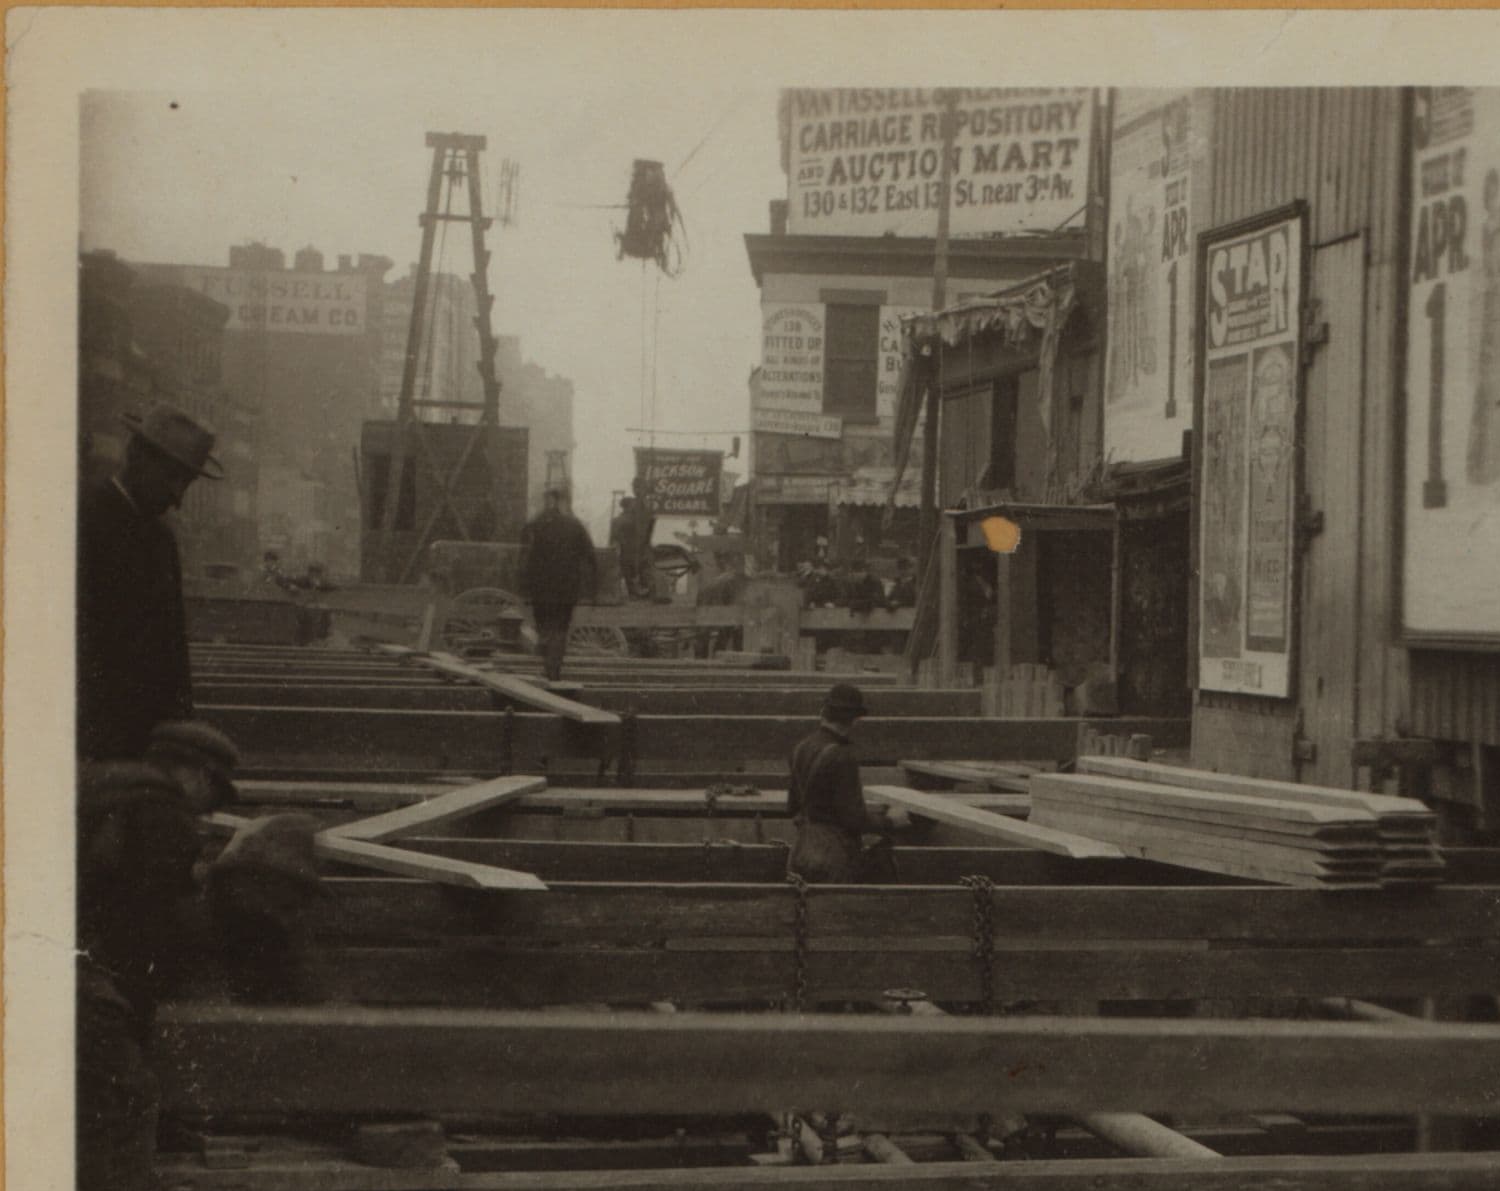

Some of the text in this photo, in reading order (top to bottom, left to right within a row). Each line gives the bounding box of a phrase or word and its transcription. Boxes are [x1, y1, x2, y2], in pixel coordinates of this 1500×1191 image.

[799, 101, 1083, 153] CARRIAGE RPOSITORY
[971, 138, 1080, 174] MART
[804, 190, 834, 217] 130
[850, 187, 879, 214] 132
[885, 183, 919, 211] East
[982, 183, 1023, 206] near
[1210, 231, 1287, 347] STAR
